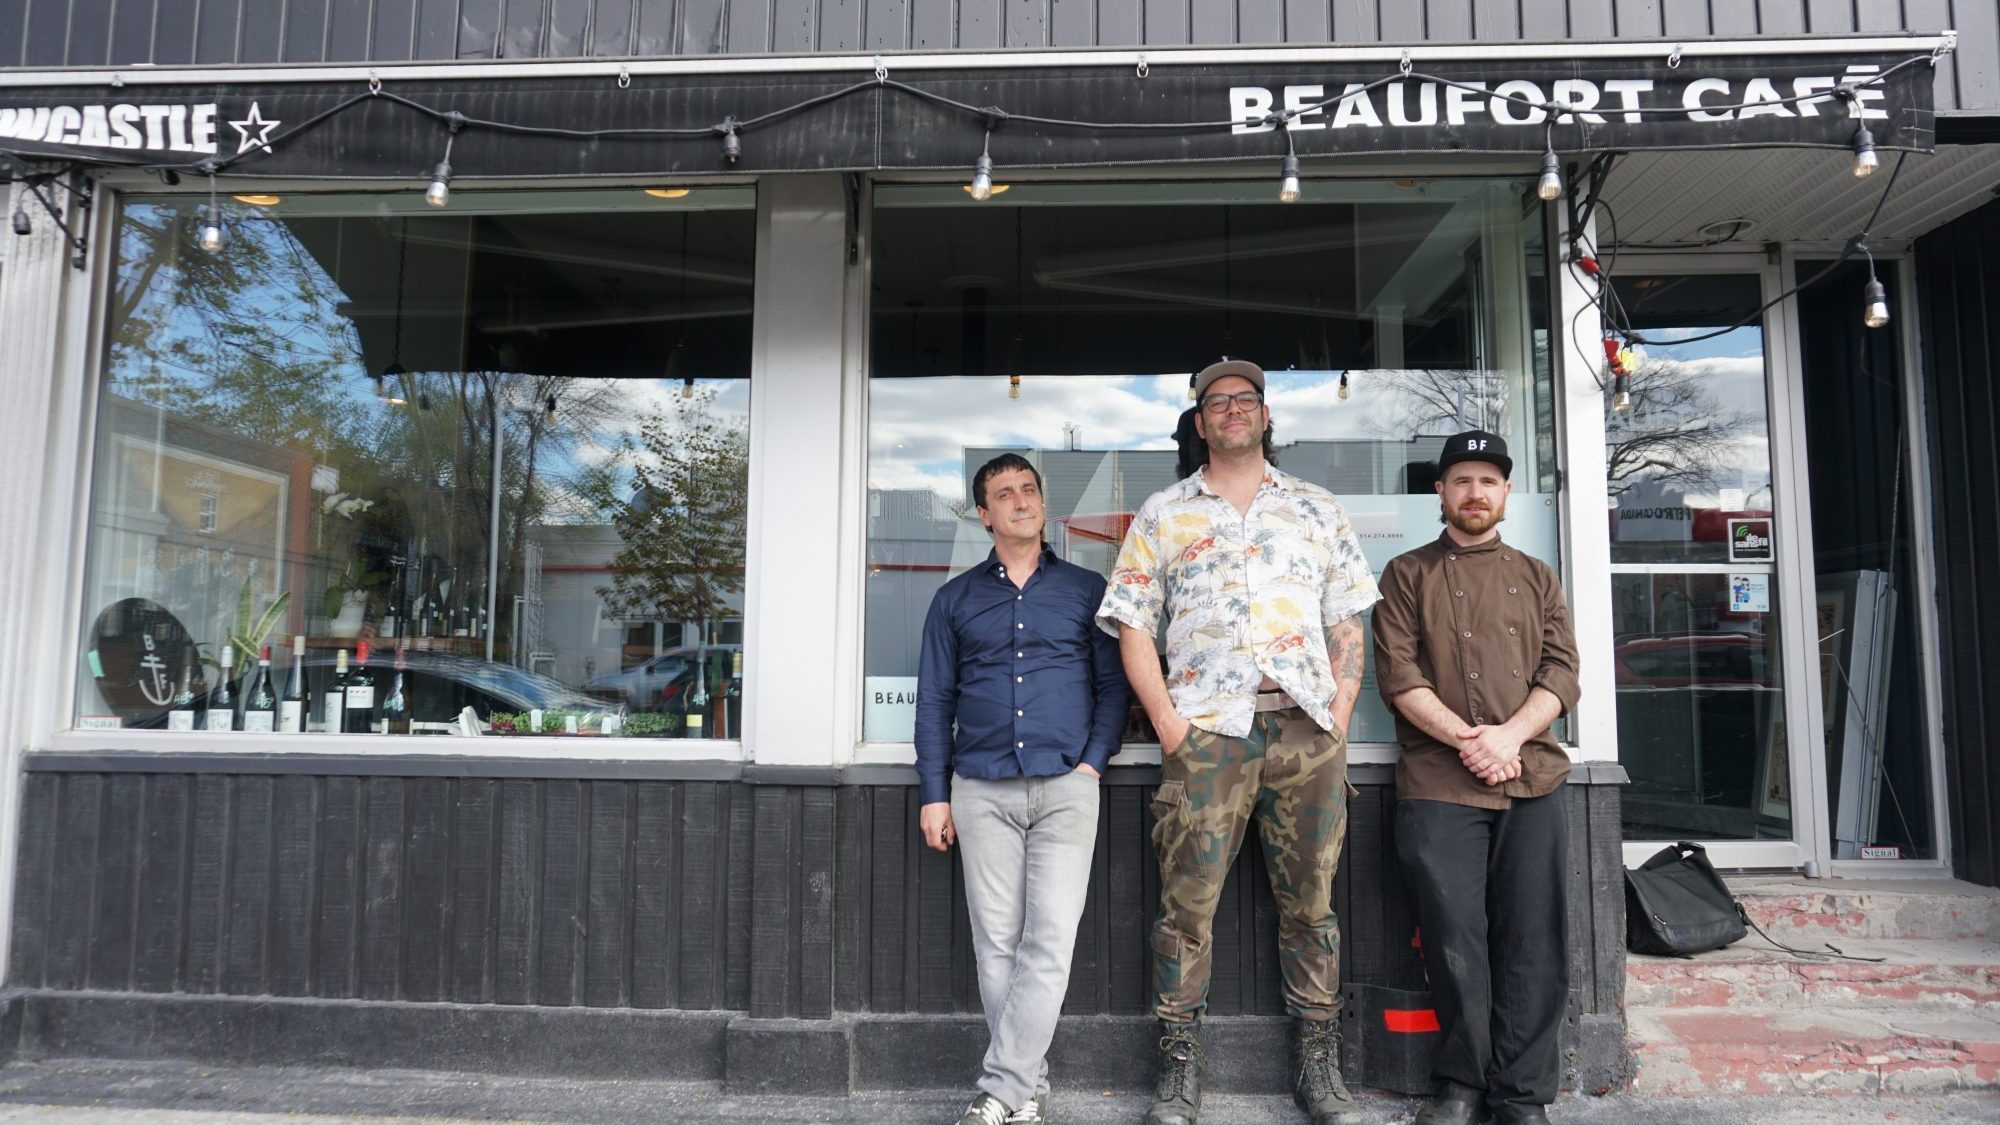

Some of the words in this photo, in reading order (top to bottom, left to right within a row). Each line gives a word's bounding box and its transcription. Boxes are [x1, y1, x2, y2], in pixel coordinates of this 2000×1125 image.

[1229, 79, 1654, 135] BEAUFORT
[0, 104, 217, 154] WCASTLE
[874, 692, 916, 705] BEAU
[1864, 848, 1896, 857] Signal
